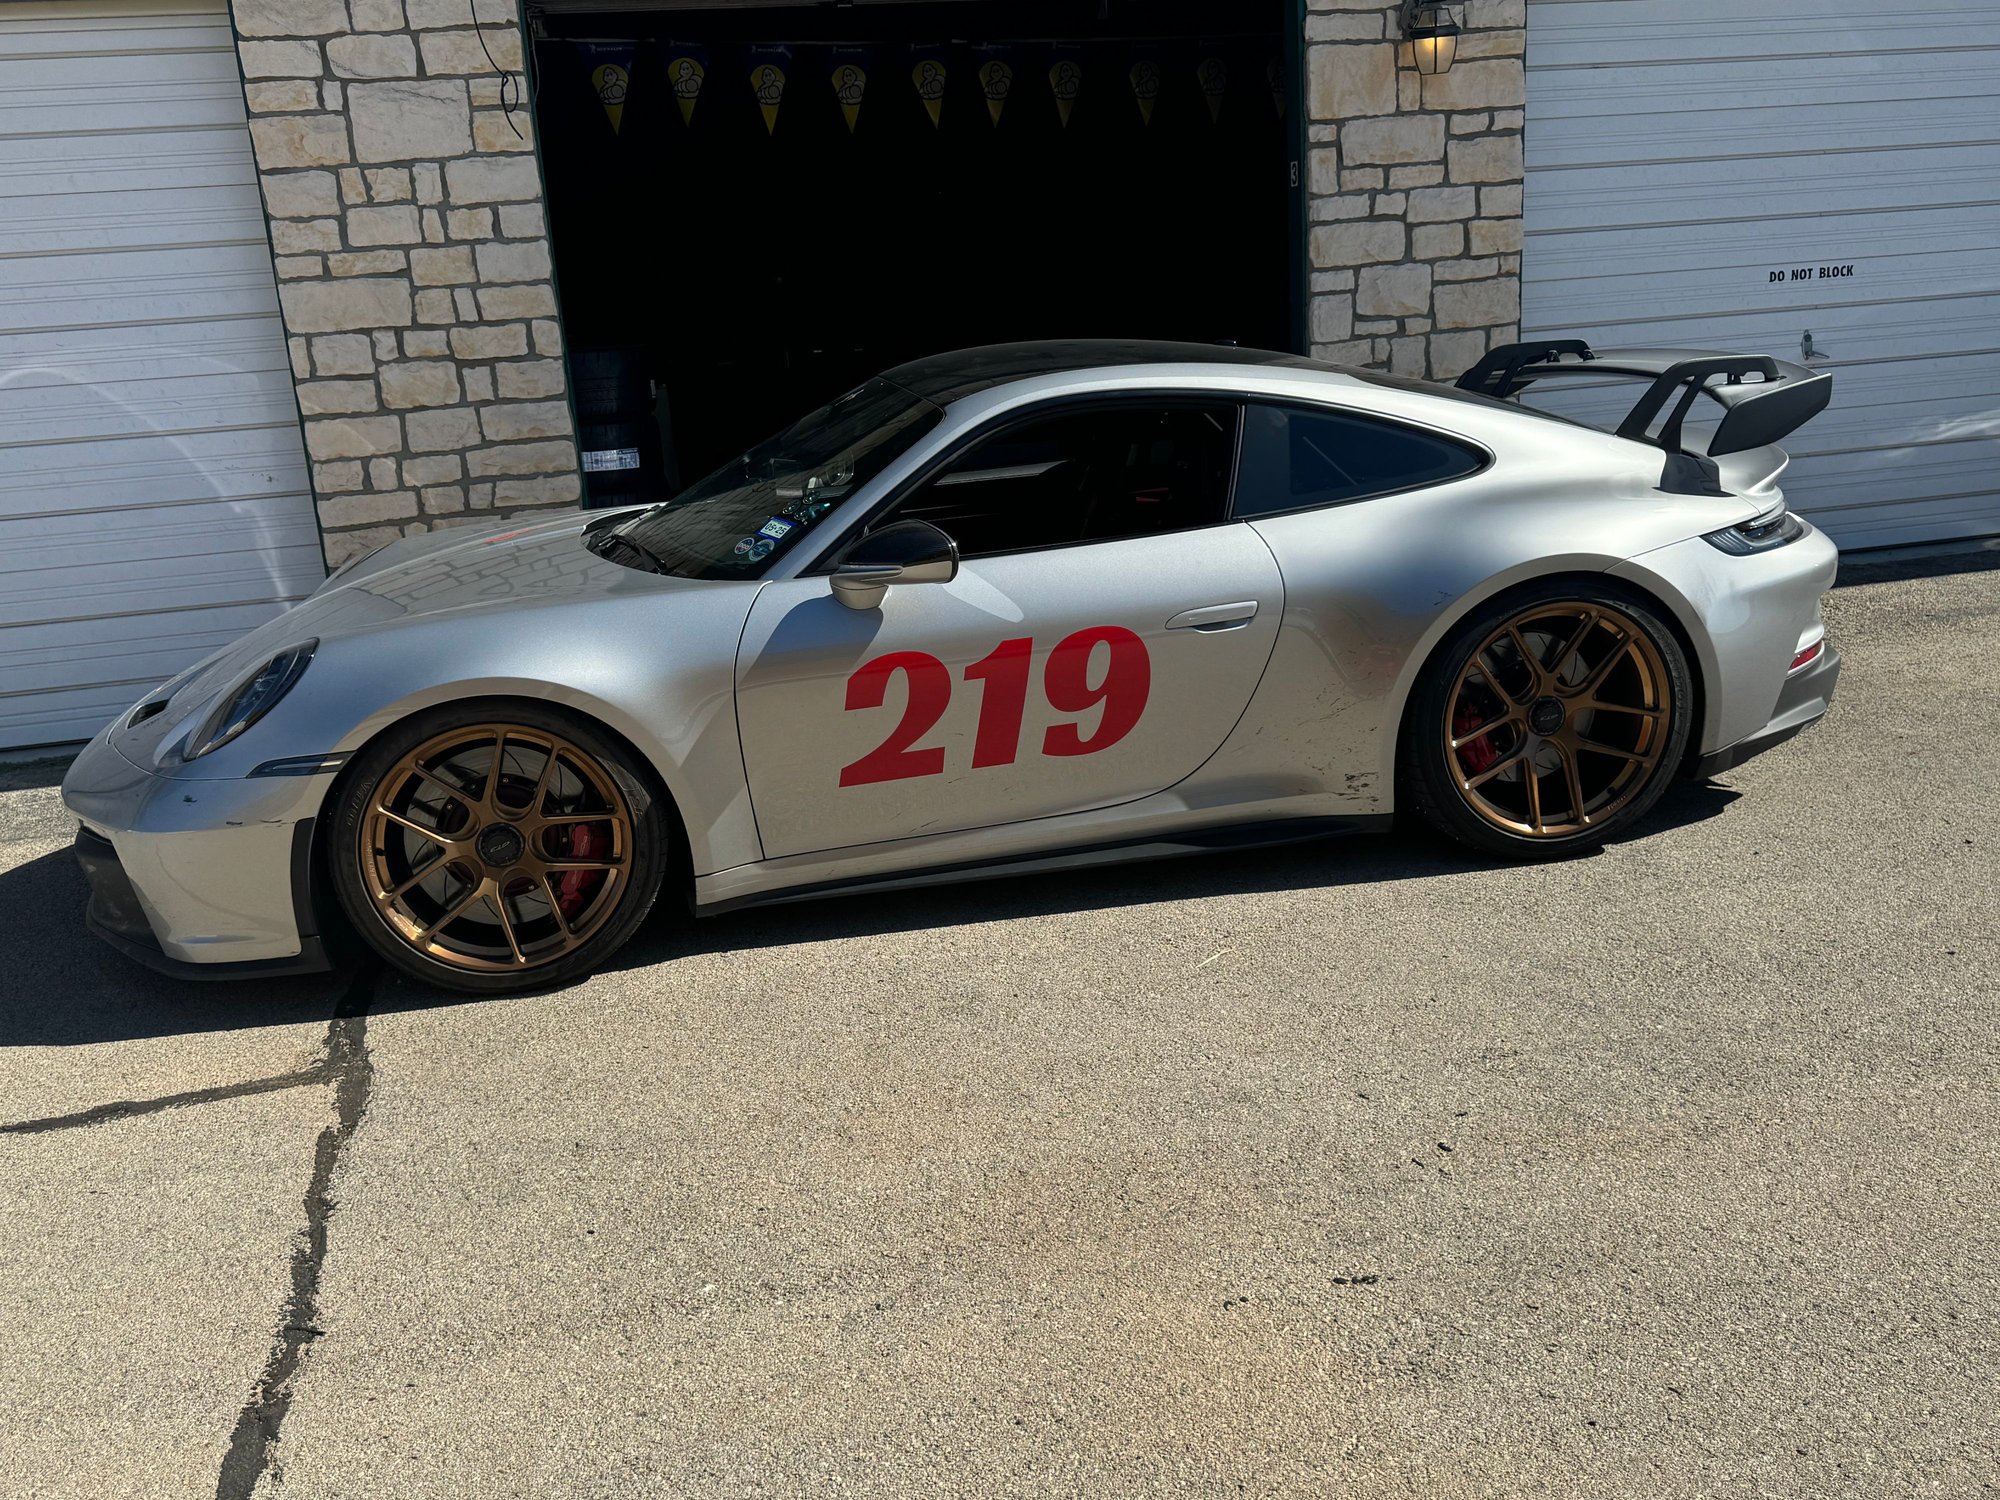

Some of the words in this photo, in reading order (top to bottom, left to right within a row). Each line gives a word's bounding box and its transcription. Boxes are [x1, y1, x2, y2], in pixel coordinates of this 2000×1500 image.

[1291, 162, 1298, 185] 3
[1769, 270, 1785, 283] DO
[1791, 268, 1813, 281] NOT
[1819, 265, 1854, 279] BLOCK
[838, 625, 1151, 788] 219
